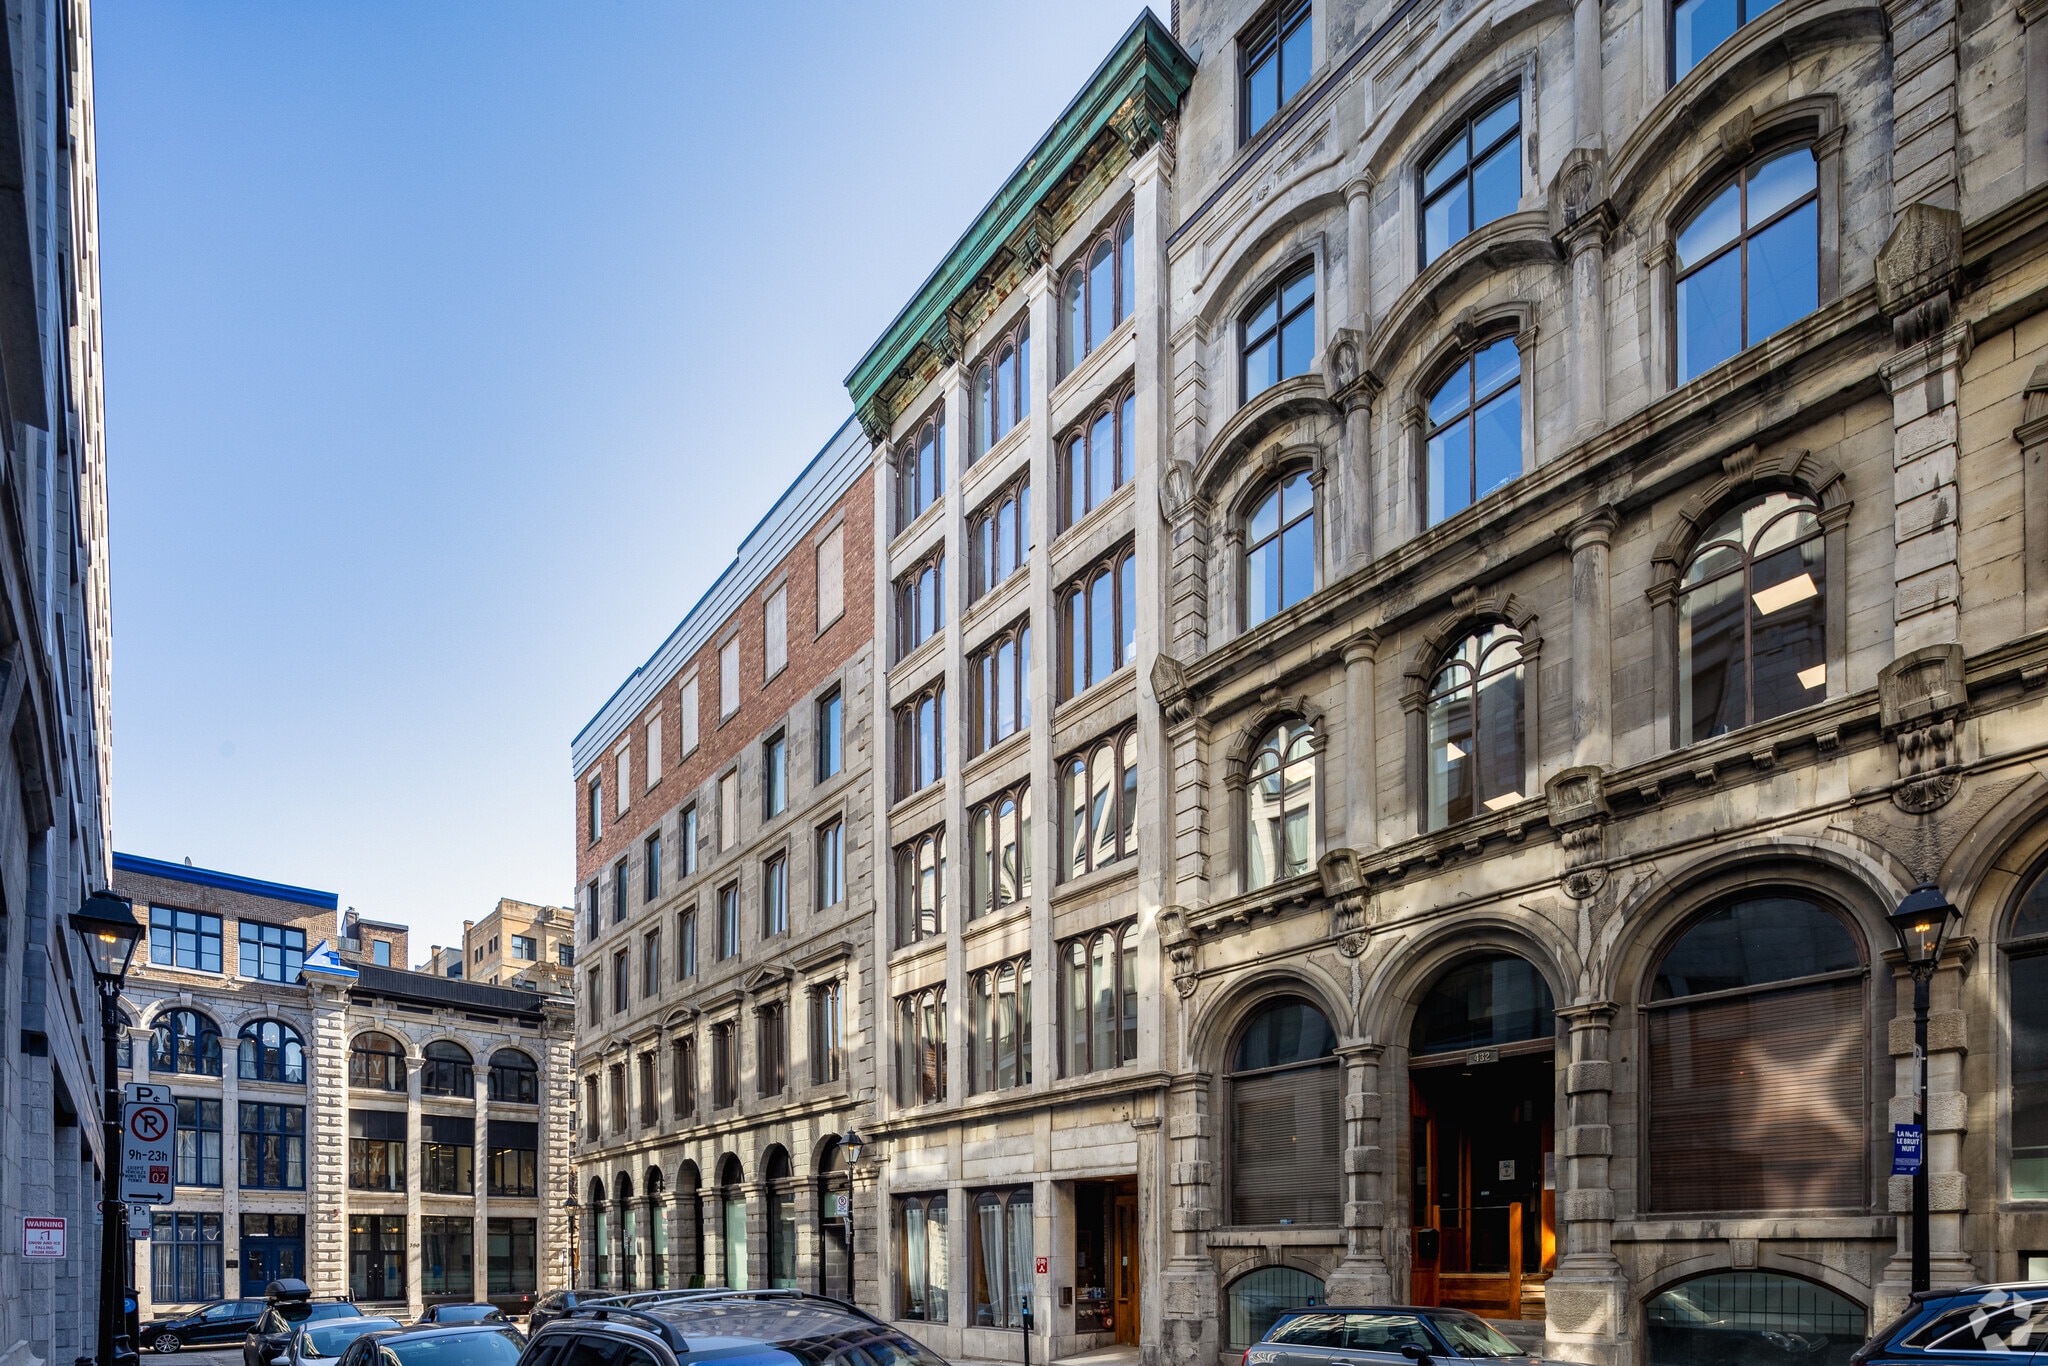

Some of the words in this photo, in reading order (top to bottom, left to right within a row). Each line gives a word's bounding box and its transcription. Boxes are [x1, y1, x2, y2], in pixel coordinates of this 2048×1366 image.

[1474, 1052, 1490, 1062] 432
[129, 1149, 168, 1161] 9h-23h
[152, 1172, 166, 1183] 02
